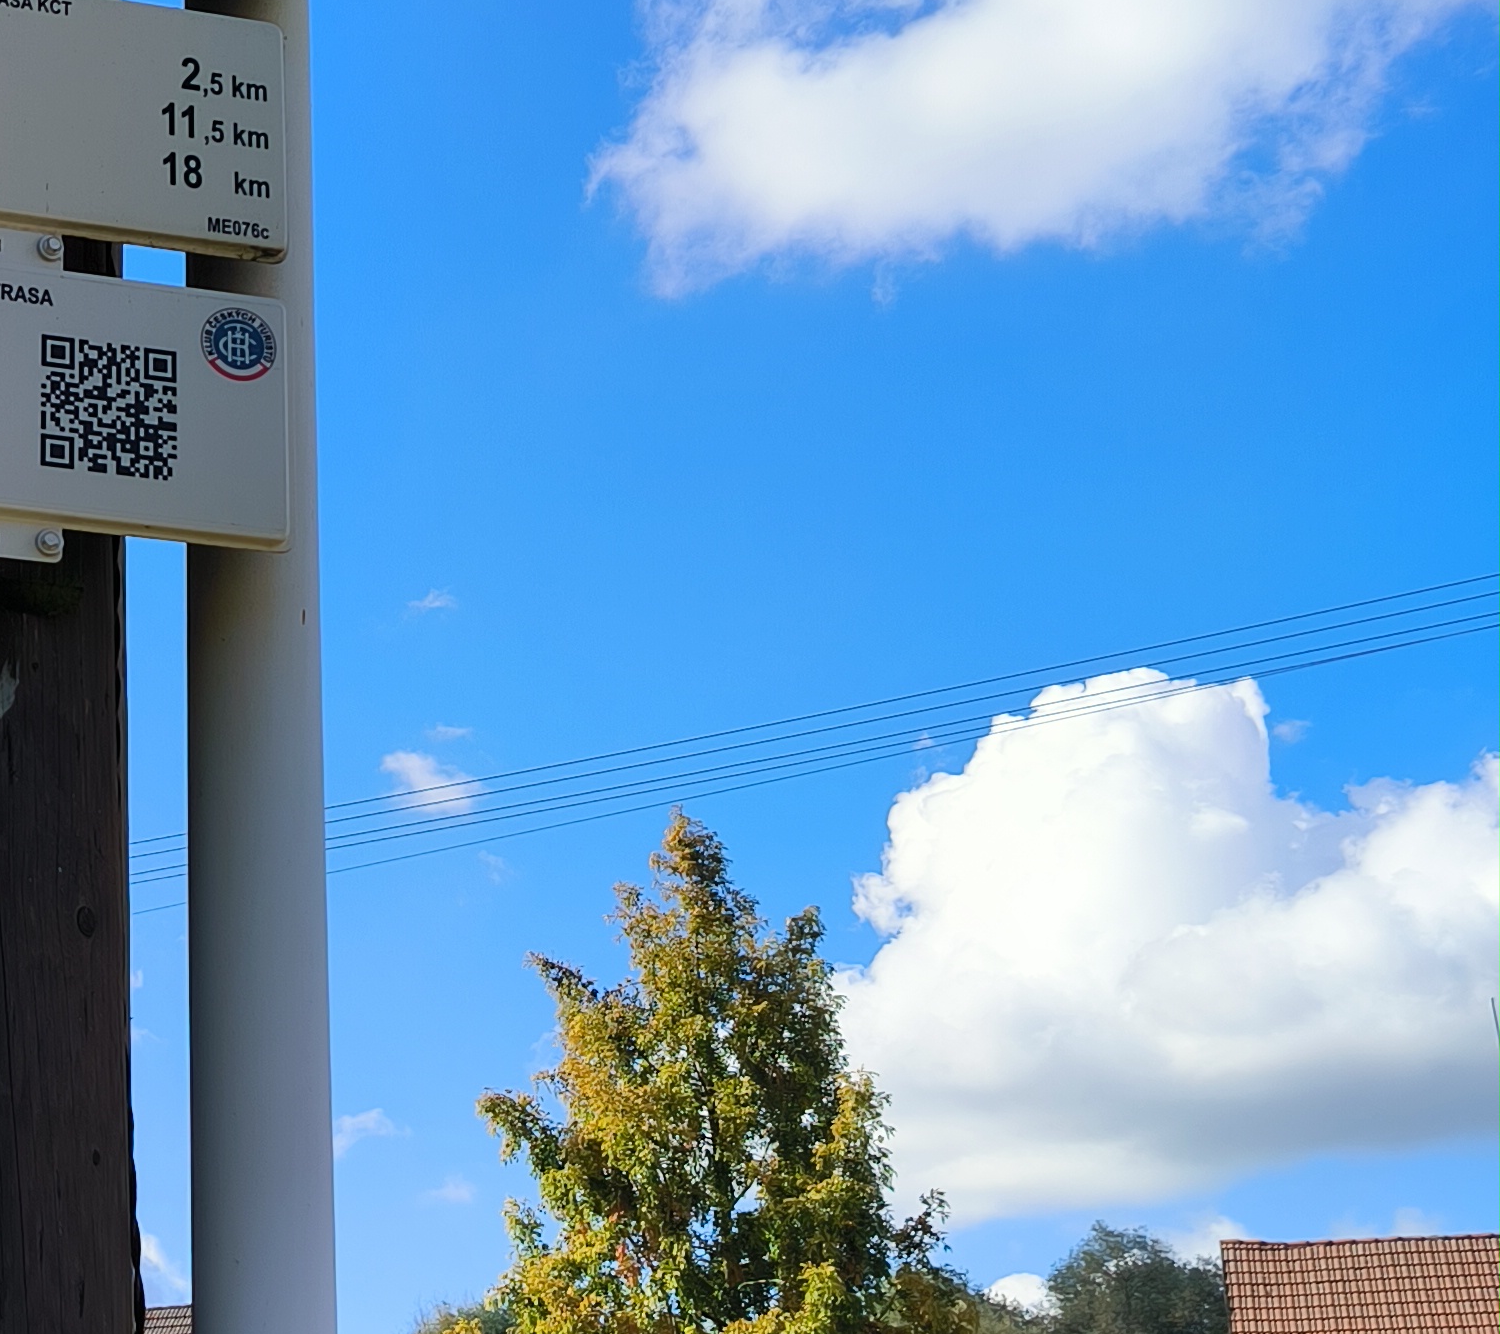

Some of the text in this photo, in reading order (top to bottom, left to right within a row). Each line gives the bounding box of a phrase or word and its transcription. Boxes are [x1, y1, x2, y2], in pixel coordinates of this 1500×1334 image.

[181, 57, 267, 102] 2,5 km
[161, 102, 269, 149] 11,5 km
[162, 151, 270, 199] 18 km
[208, 217, 270, 240] ME076c
[204, 329, 215, 357] KLUB
